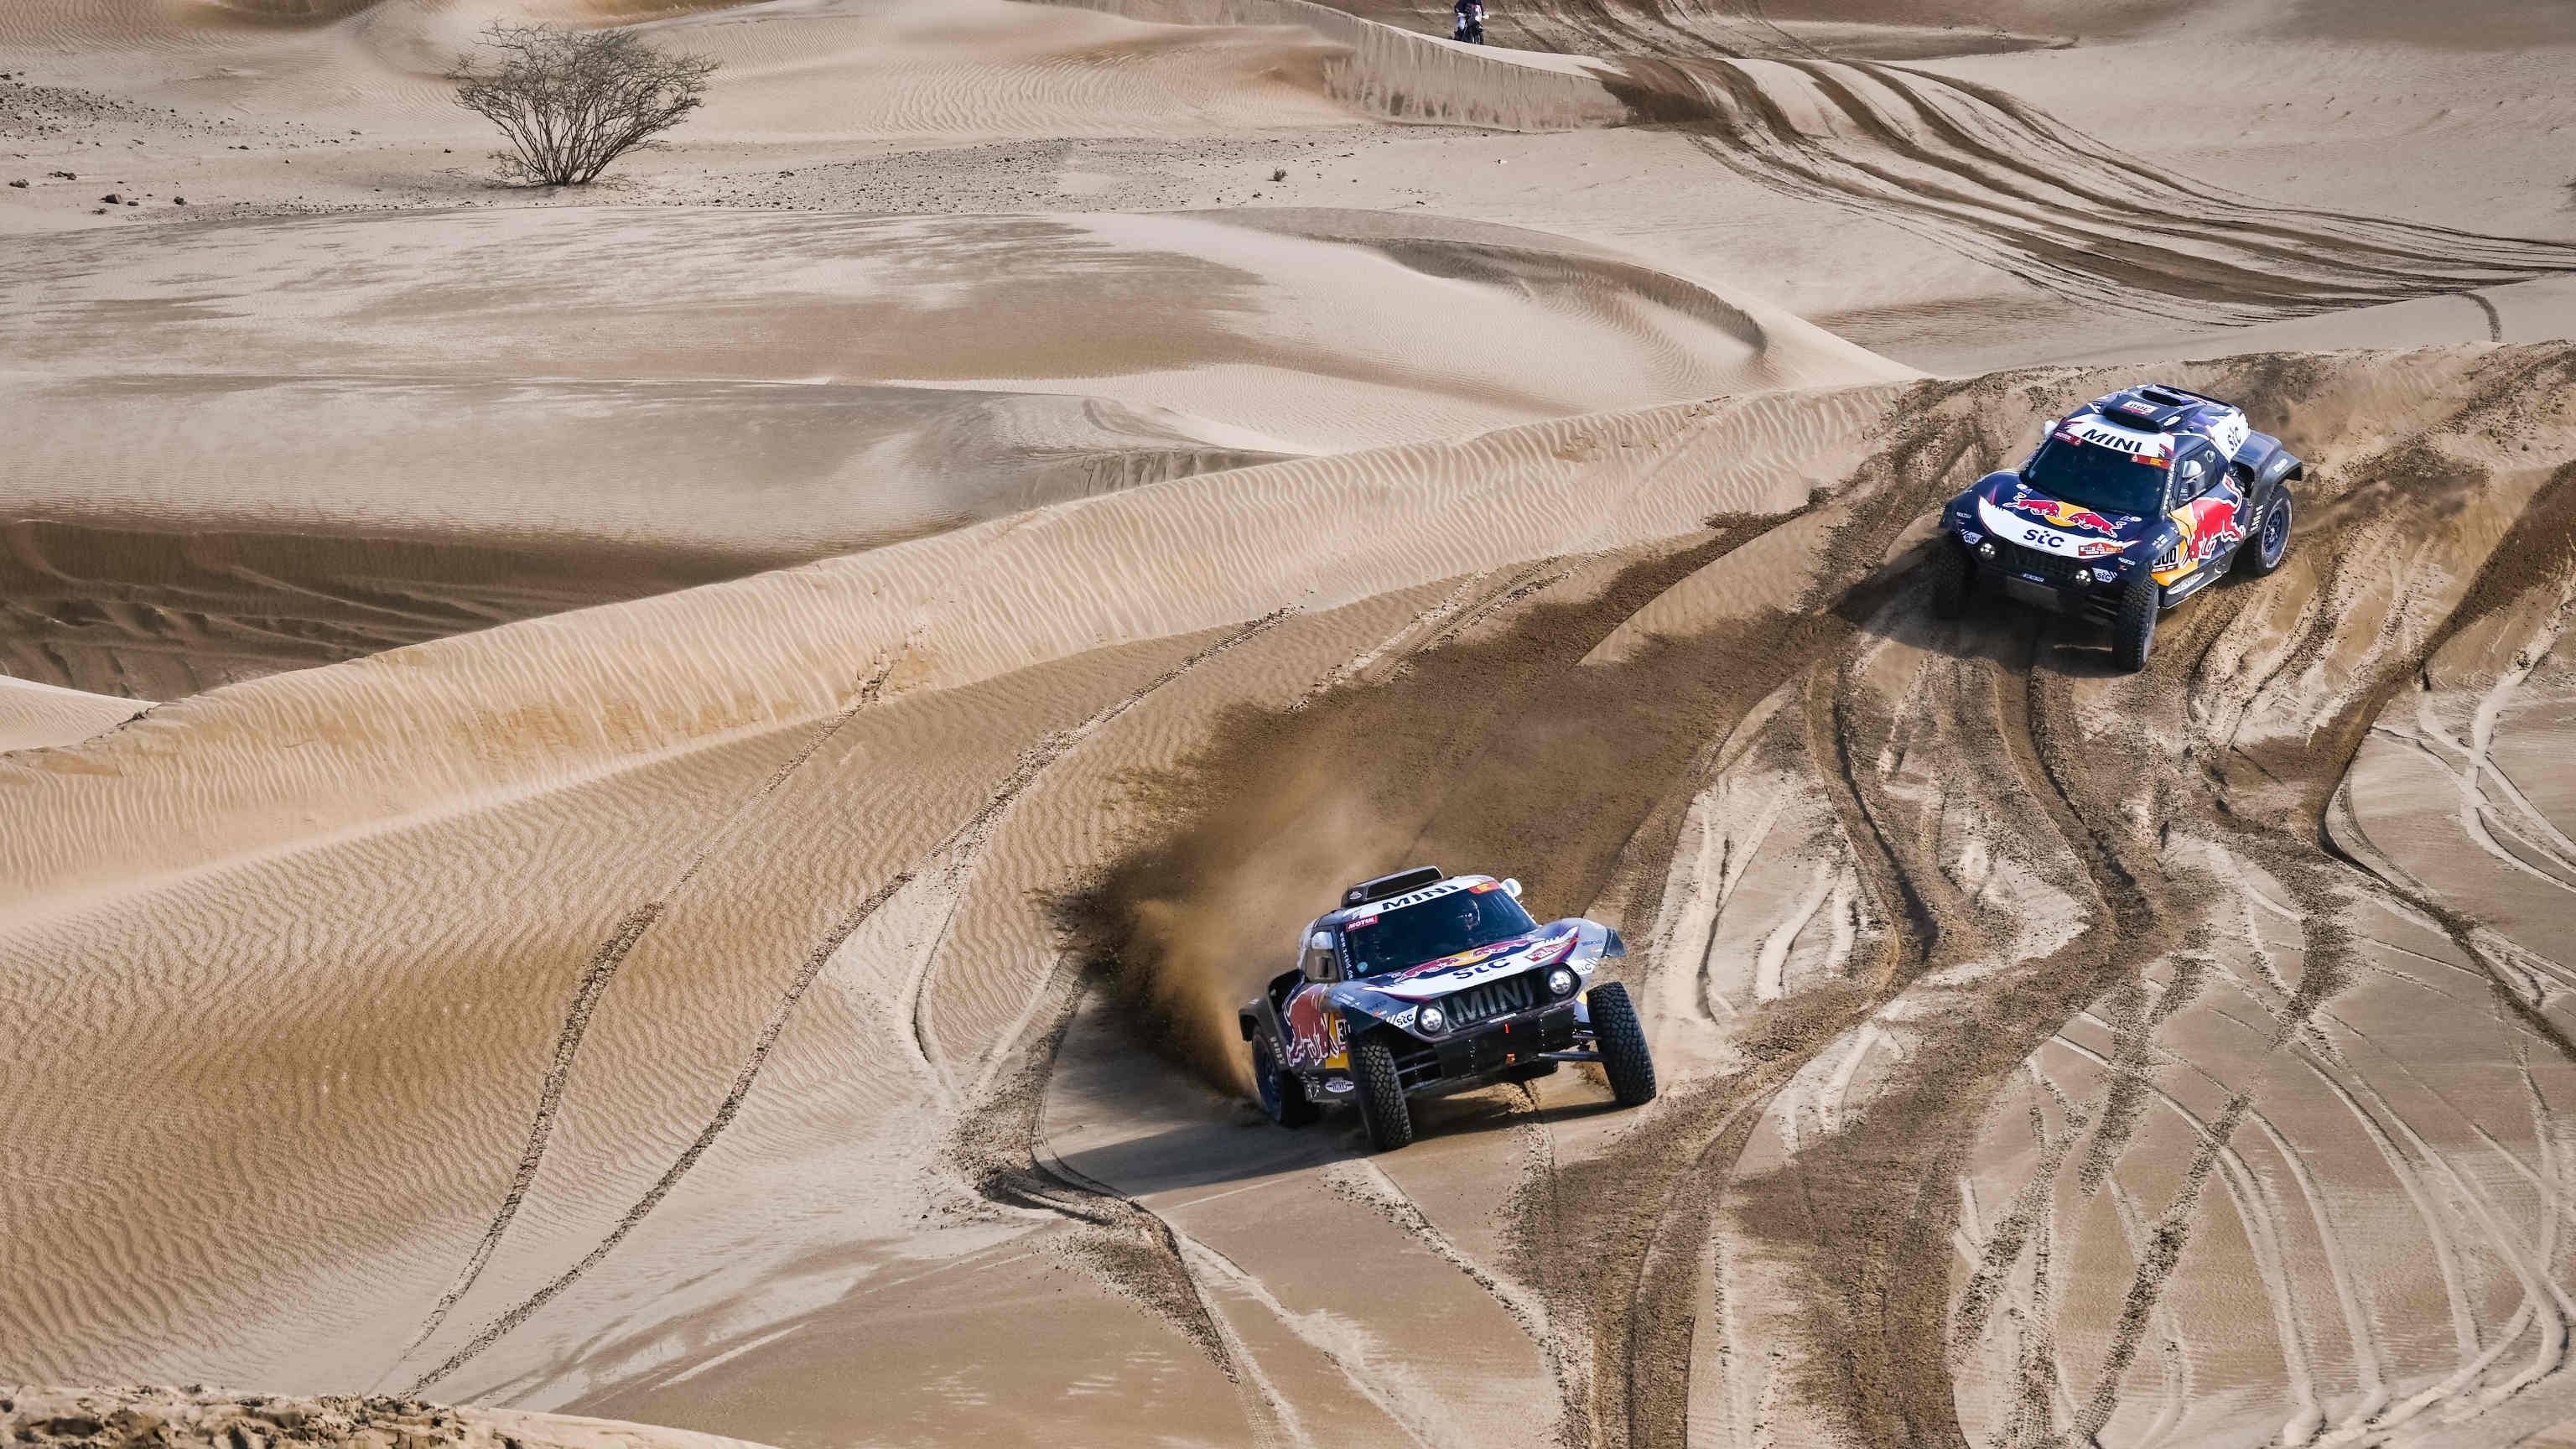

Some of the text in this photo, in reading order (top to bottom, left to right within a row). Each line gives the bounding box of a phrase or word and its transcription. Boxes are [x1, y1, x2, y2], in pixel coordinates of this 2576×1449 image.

[2082, 428, 2142, 454] MINI
[1382, 885, 1459, 911] MINI
[1348, 917, 1375, 931] MOTUL
[1456, 977, 1535, 1024] MINI
